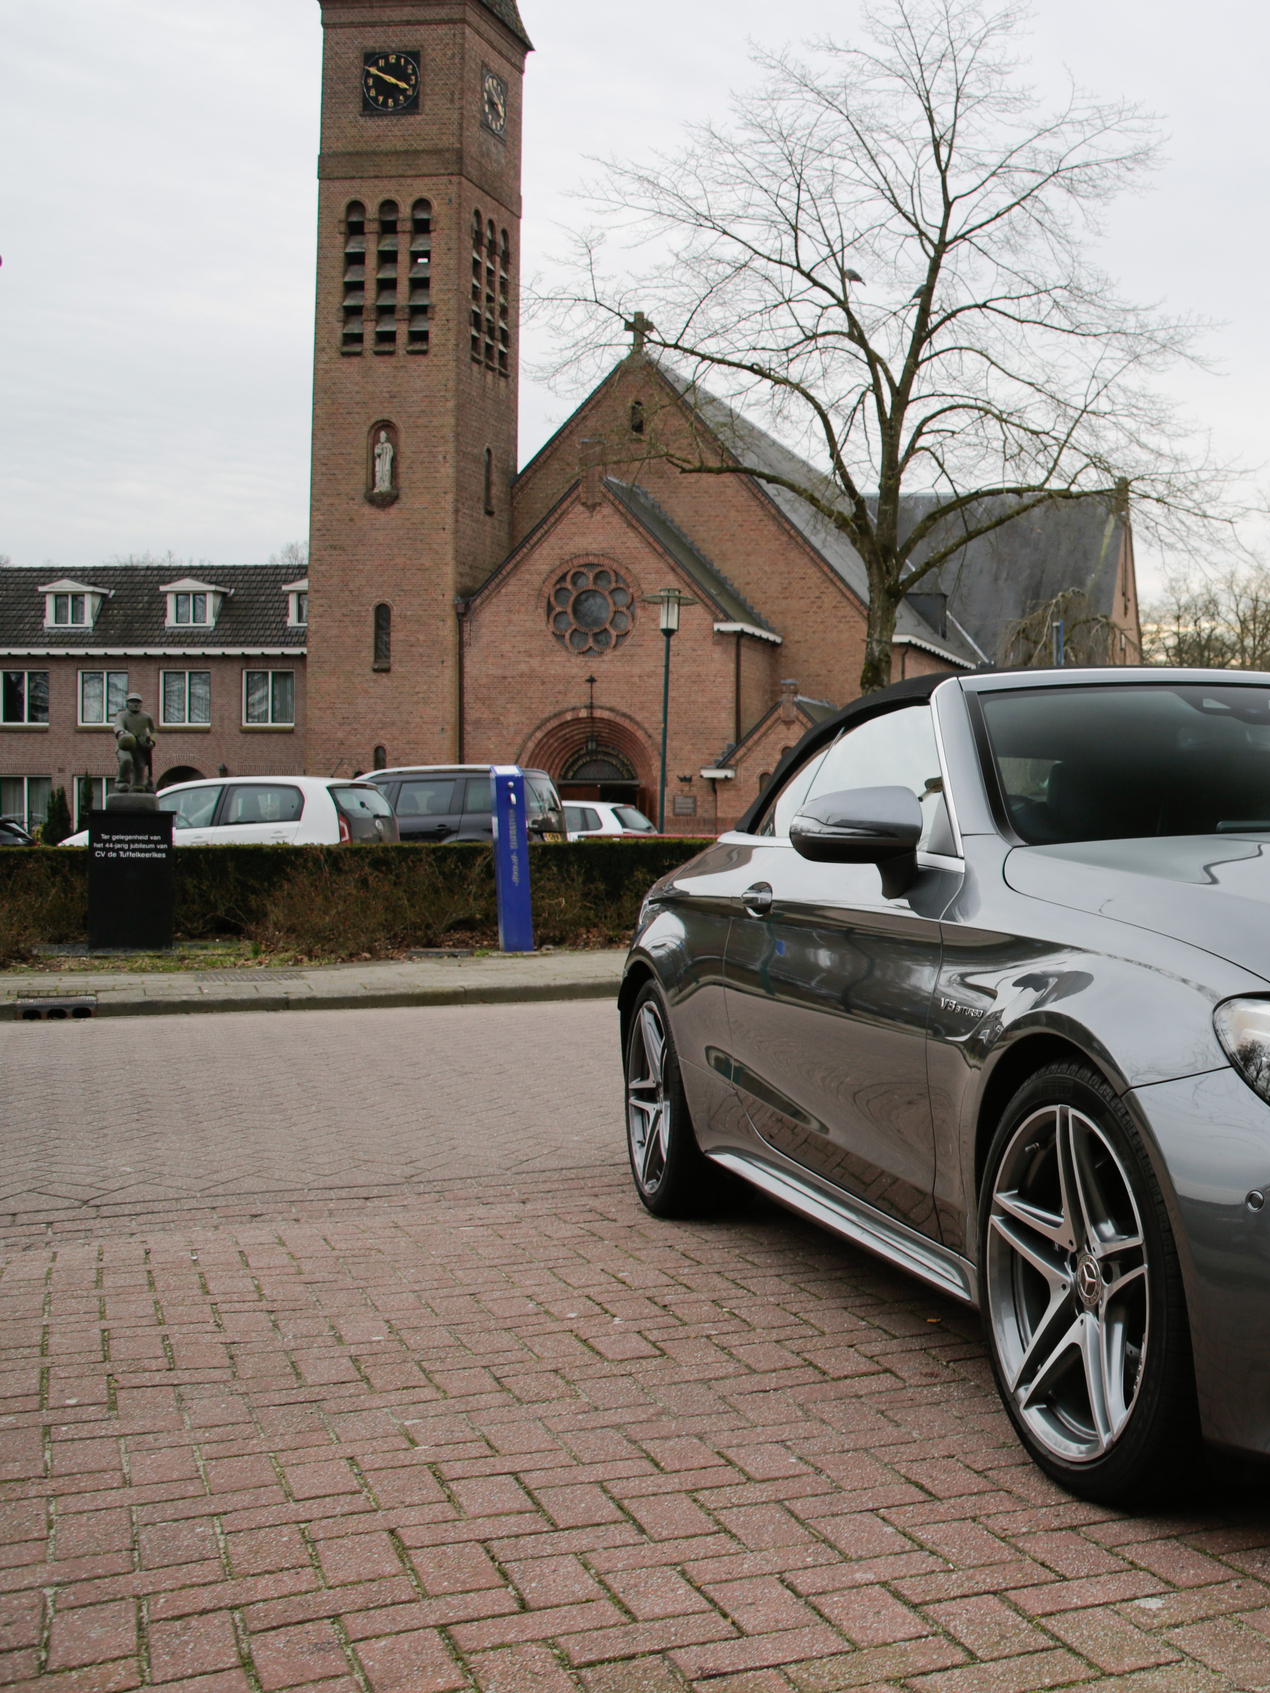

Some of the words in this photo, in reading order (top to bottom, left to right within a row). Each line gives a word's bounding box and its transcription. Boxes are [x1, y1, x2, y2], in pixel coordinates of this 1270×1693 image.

[389, 54, 397, 63] 12
[367, 77, 373, 86] 9
[410, 75, 415, 84] 3
[378, 95, 384, 105] 7
[941, 997, 957, 1011] V8
